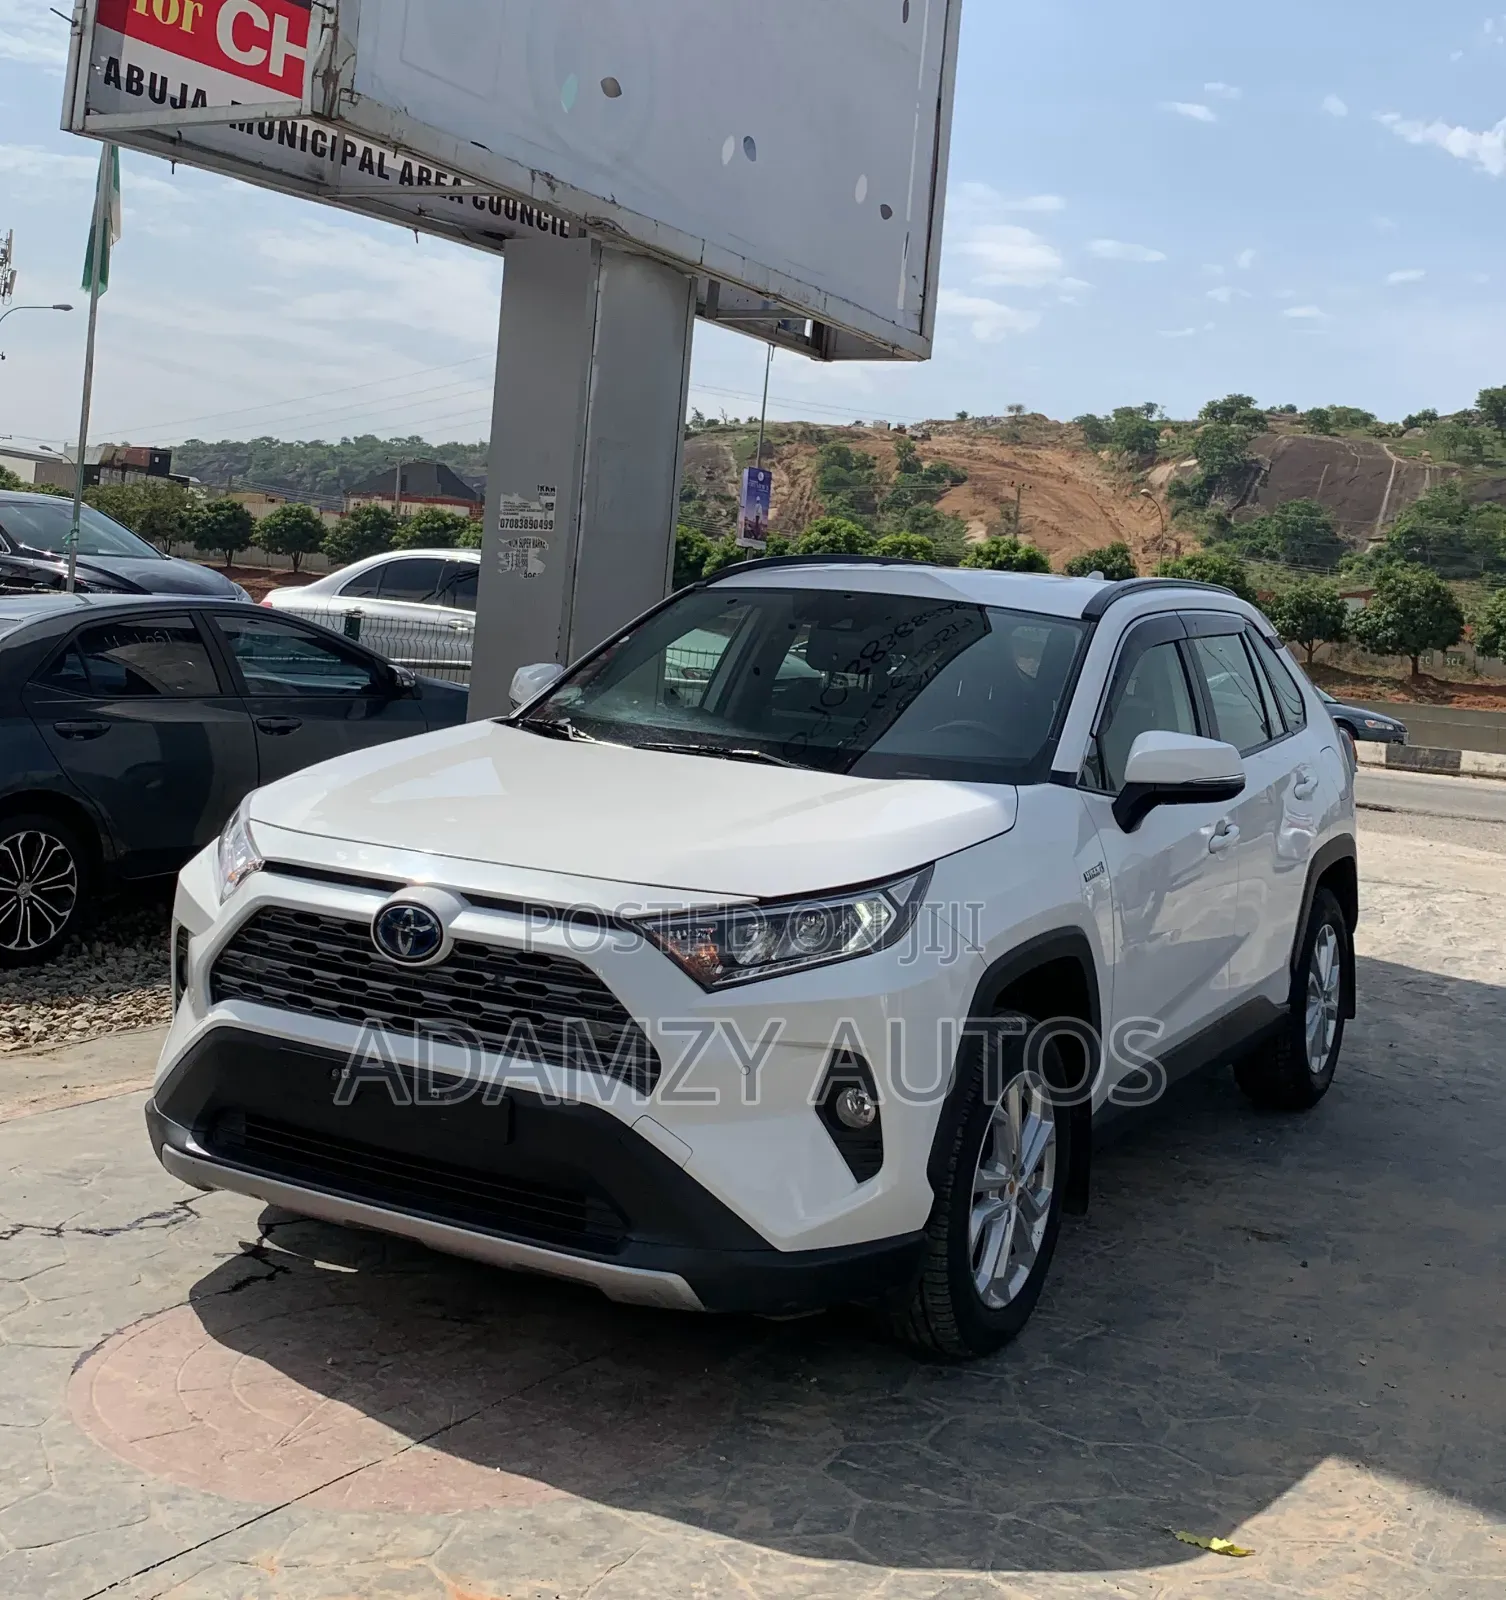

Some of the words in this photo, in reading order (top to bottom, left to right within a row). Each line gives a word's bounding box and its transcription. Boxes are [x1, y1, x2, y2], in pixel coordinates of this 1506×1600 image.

[103, 56, 208, 110] ABUJA
[398, 160, 464, 205] AREA
[472, 195, 570, 239] COUNCIL
[500, 518, 554, 530] 07083890499
